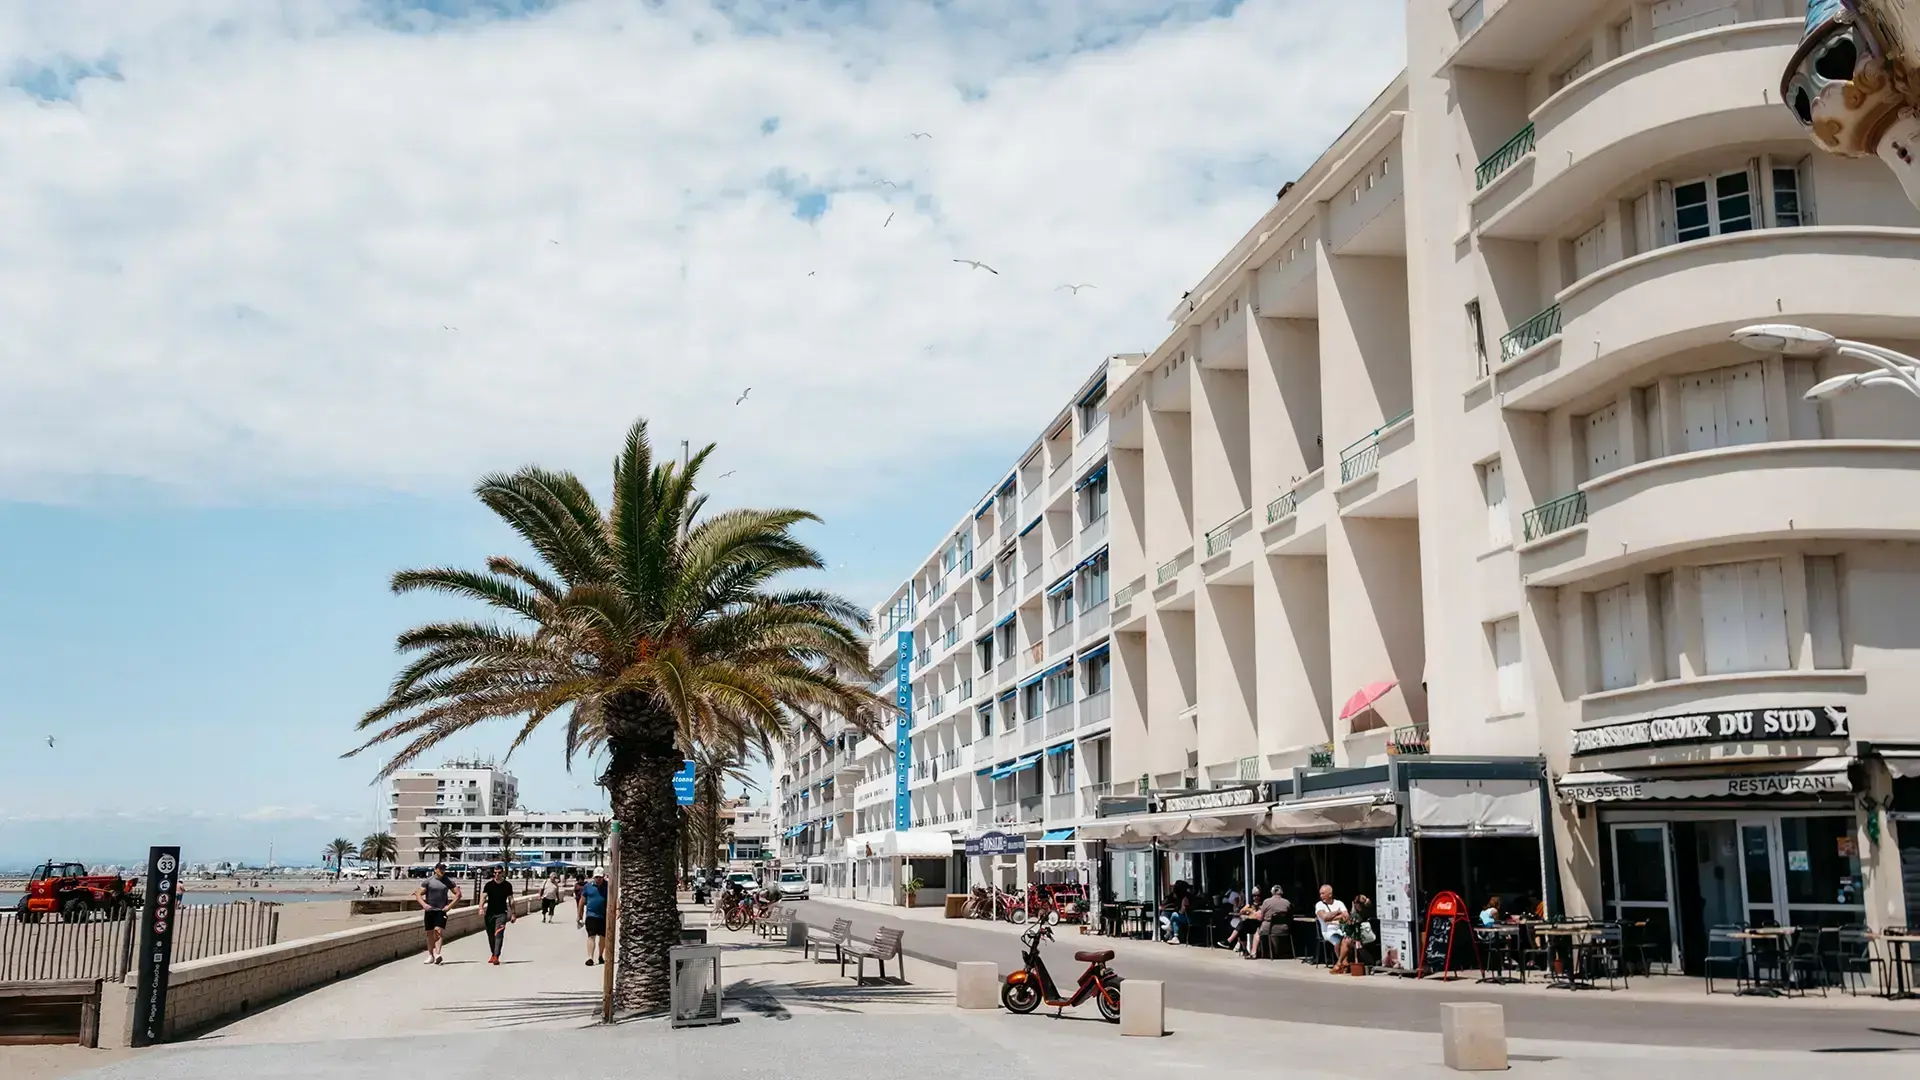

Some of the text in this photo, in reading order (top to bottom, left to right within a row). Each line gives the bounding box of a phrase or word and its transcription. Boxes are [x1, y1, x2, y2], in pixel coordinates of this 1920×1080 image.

[898, 641, 908, 795] SPLENDD HOTEL
[1650, 716, 1712, 741] CROIX
[1719, 712, 1753, 735] DU
[1763, 709, 1816, 733] SUD
[1567, 775, 1836, 799] BRASSERIE RESTAURANT
[160, 861, 173, 871] 33
[152, 963, 160, 988] Gauche
[149, 1004, 157, 1022] Plage
